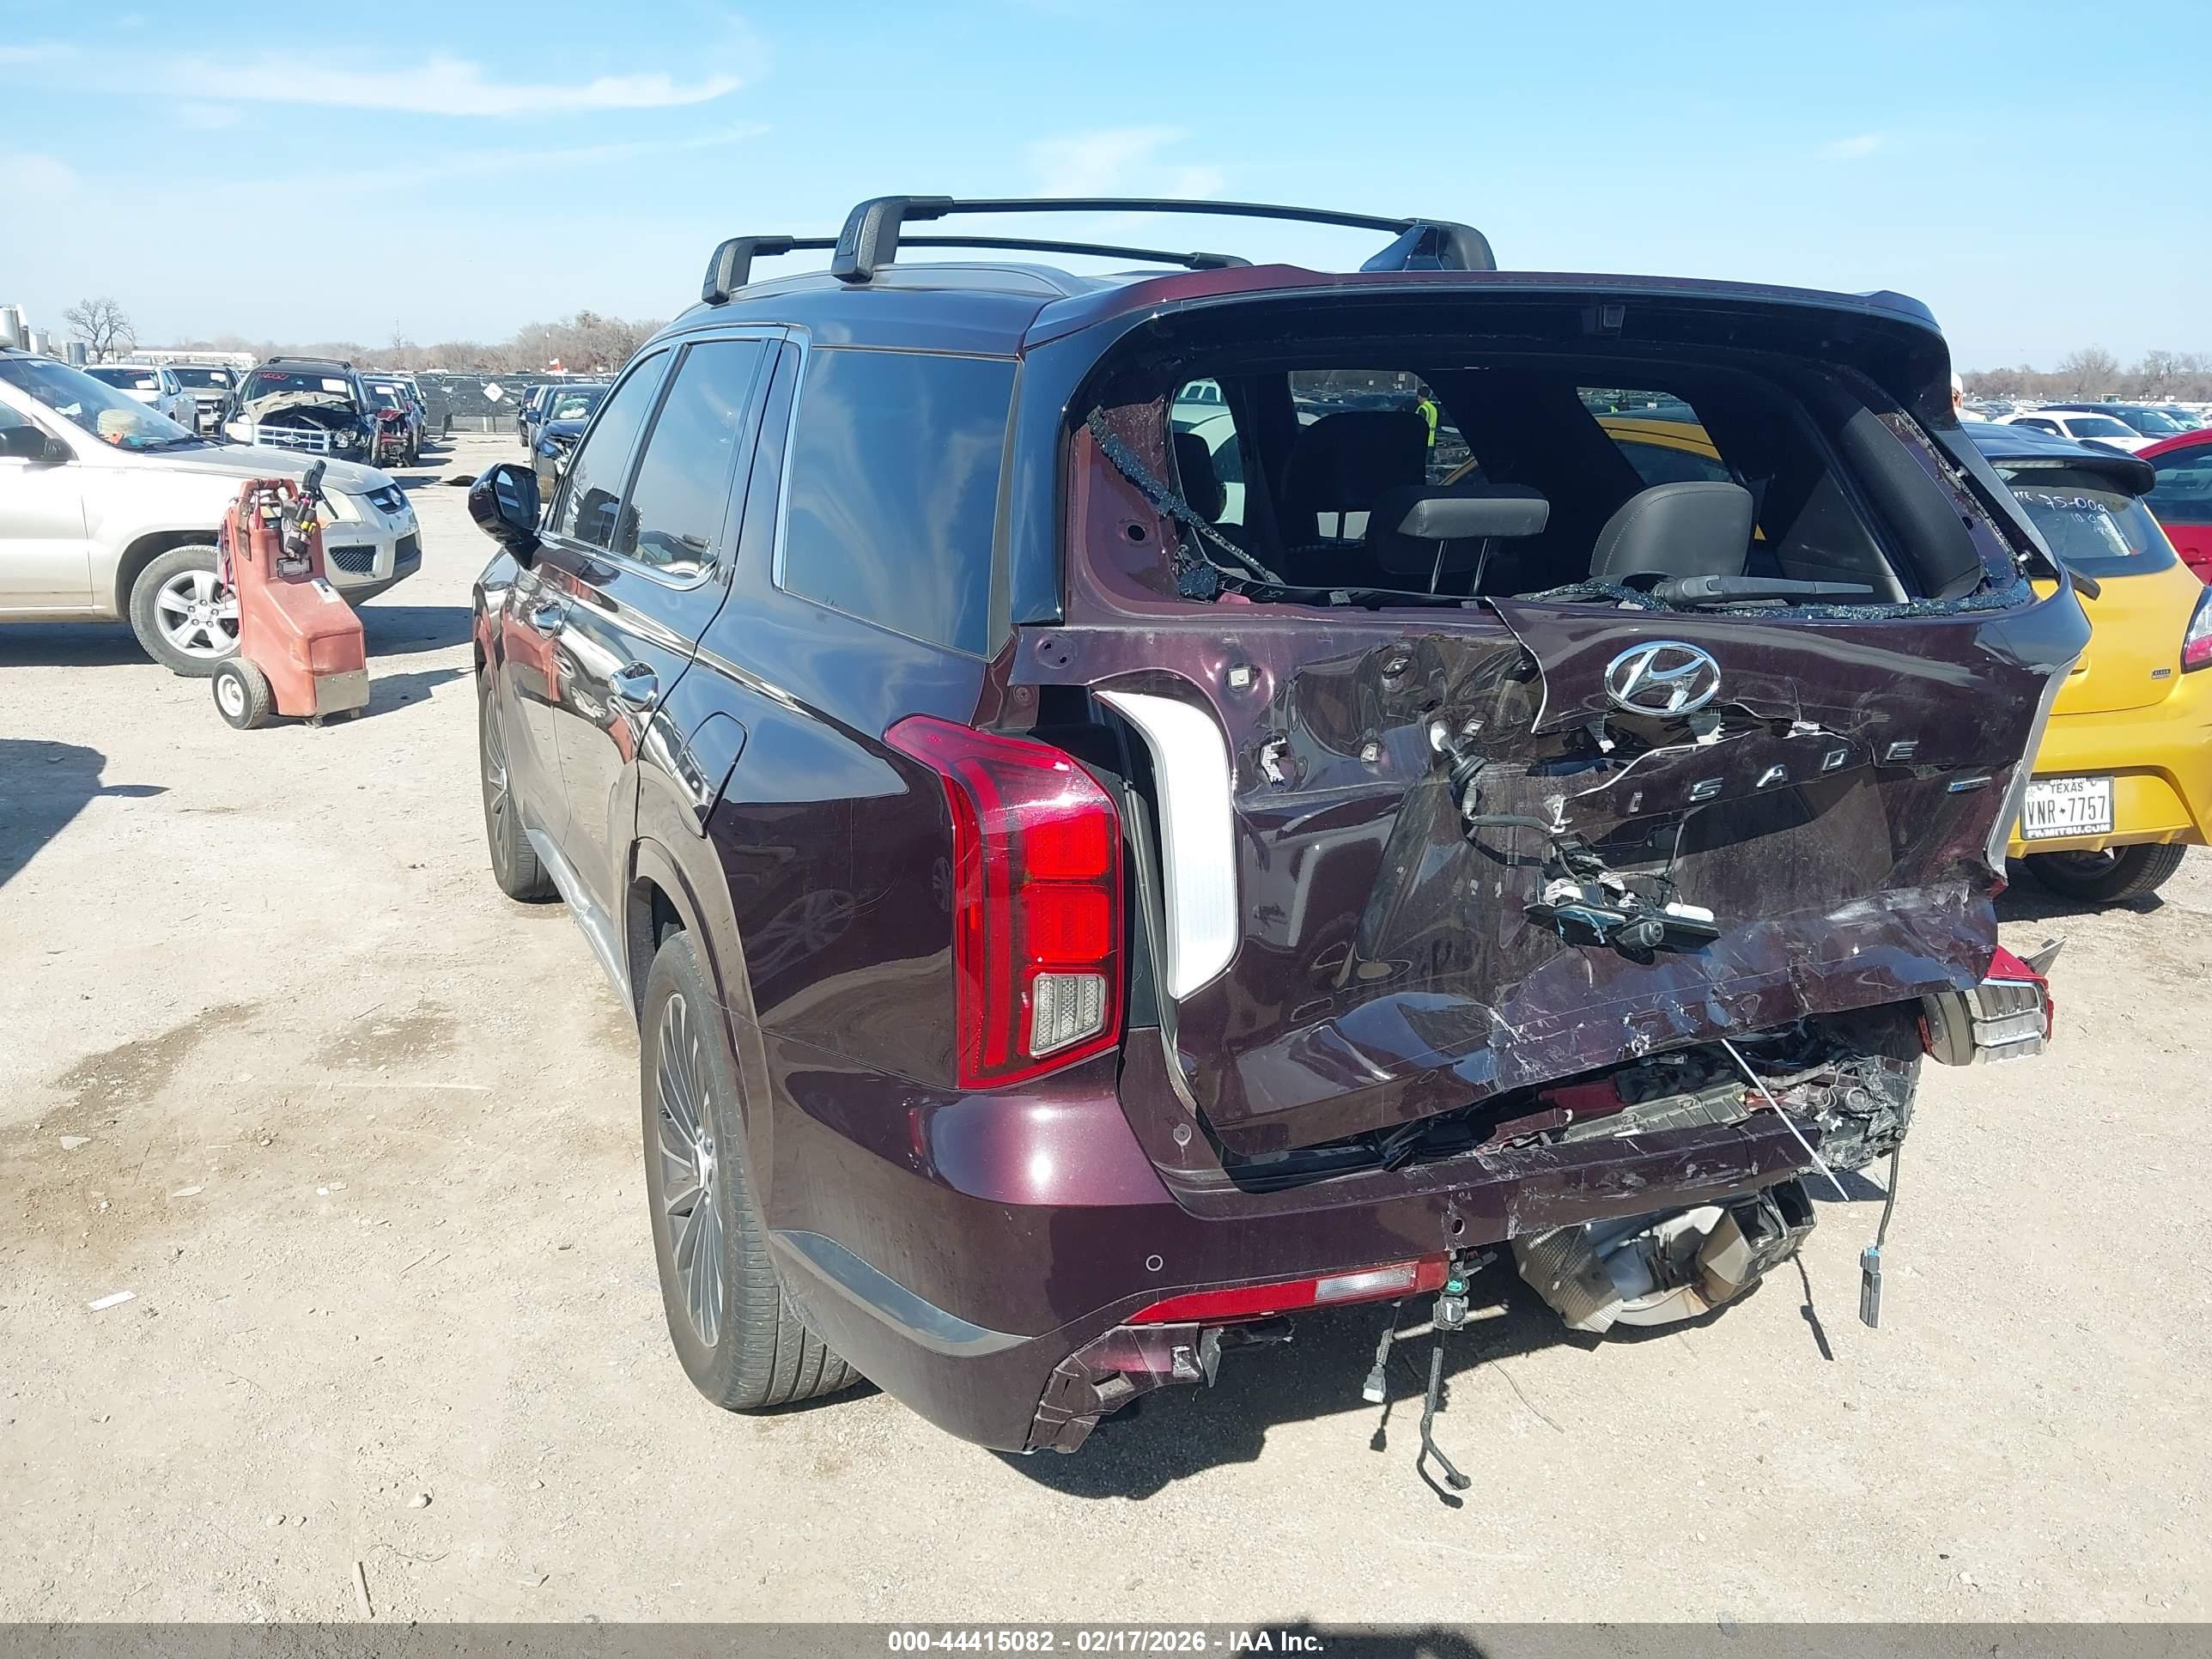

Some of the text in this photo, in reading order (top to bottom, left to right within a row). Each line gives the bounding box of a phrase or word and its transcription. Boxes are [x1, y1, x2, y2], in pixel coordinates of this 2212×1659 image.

[2051, 781, 2084, 794] TEXAS
[2027, 795, 2106, 825] VNR 7757
